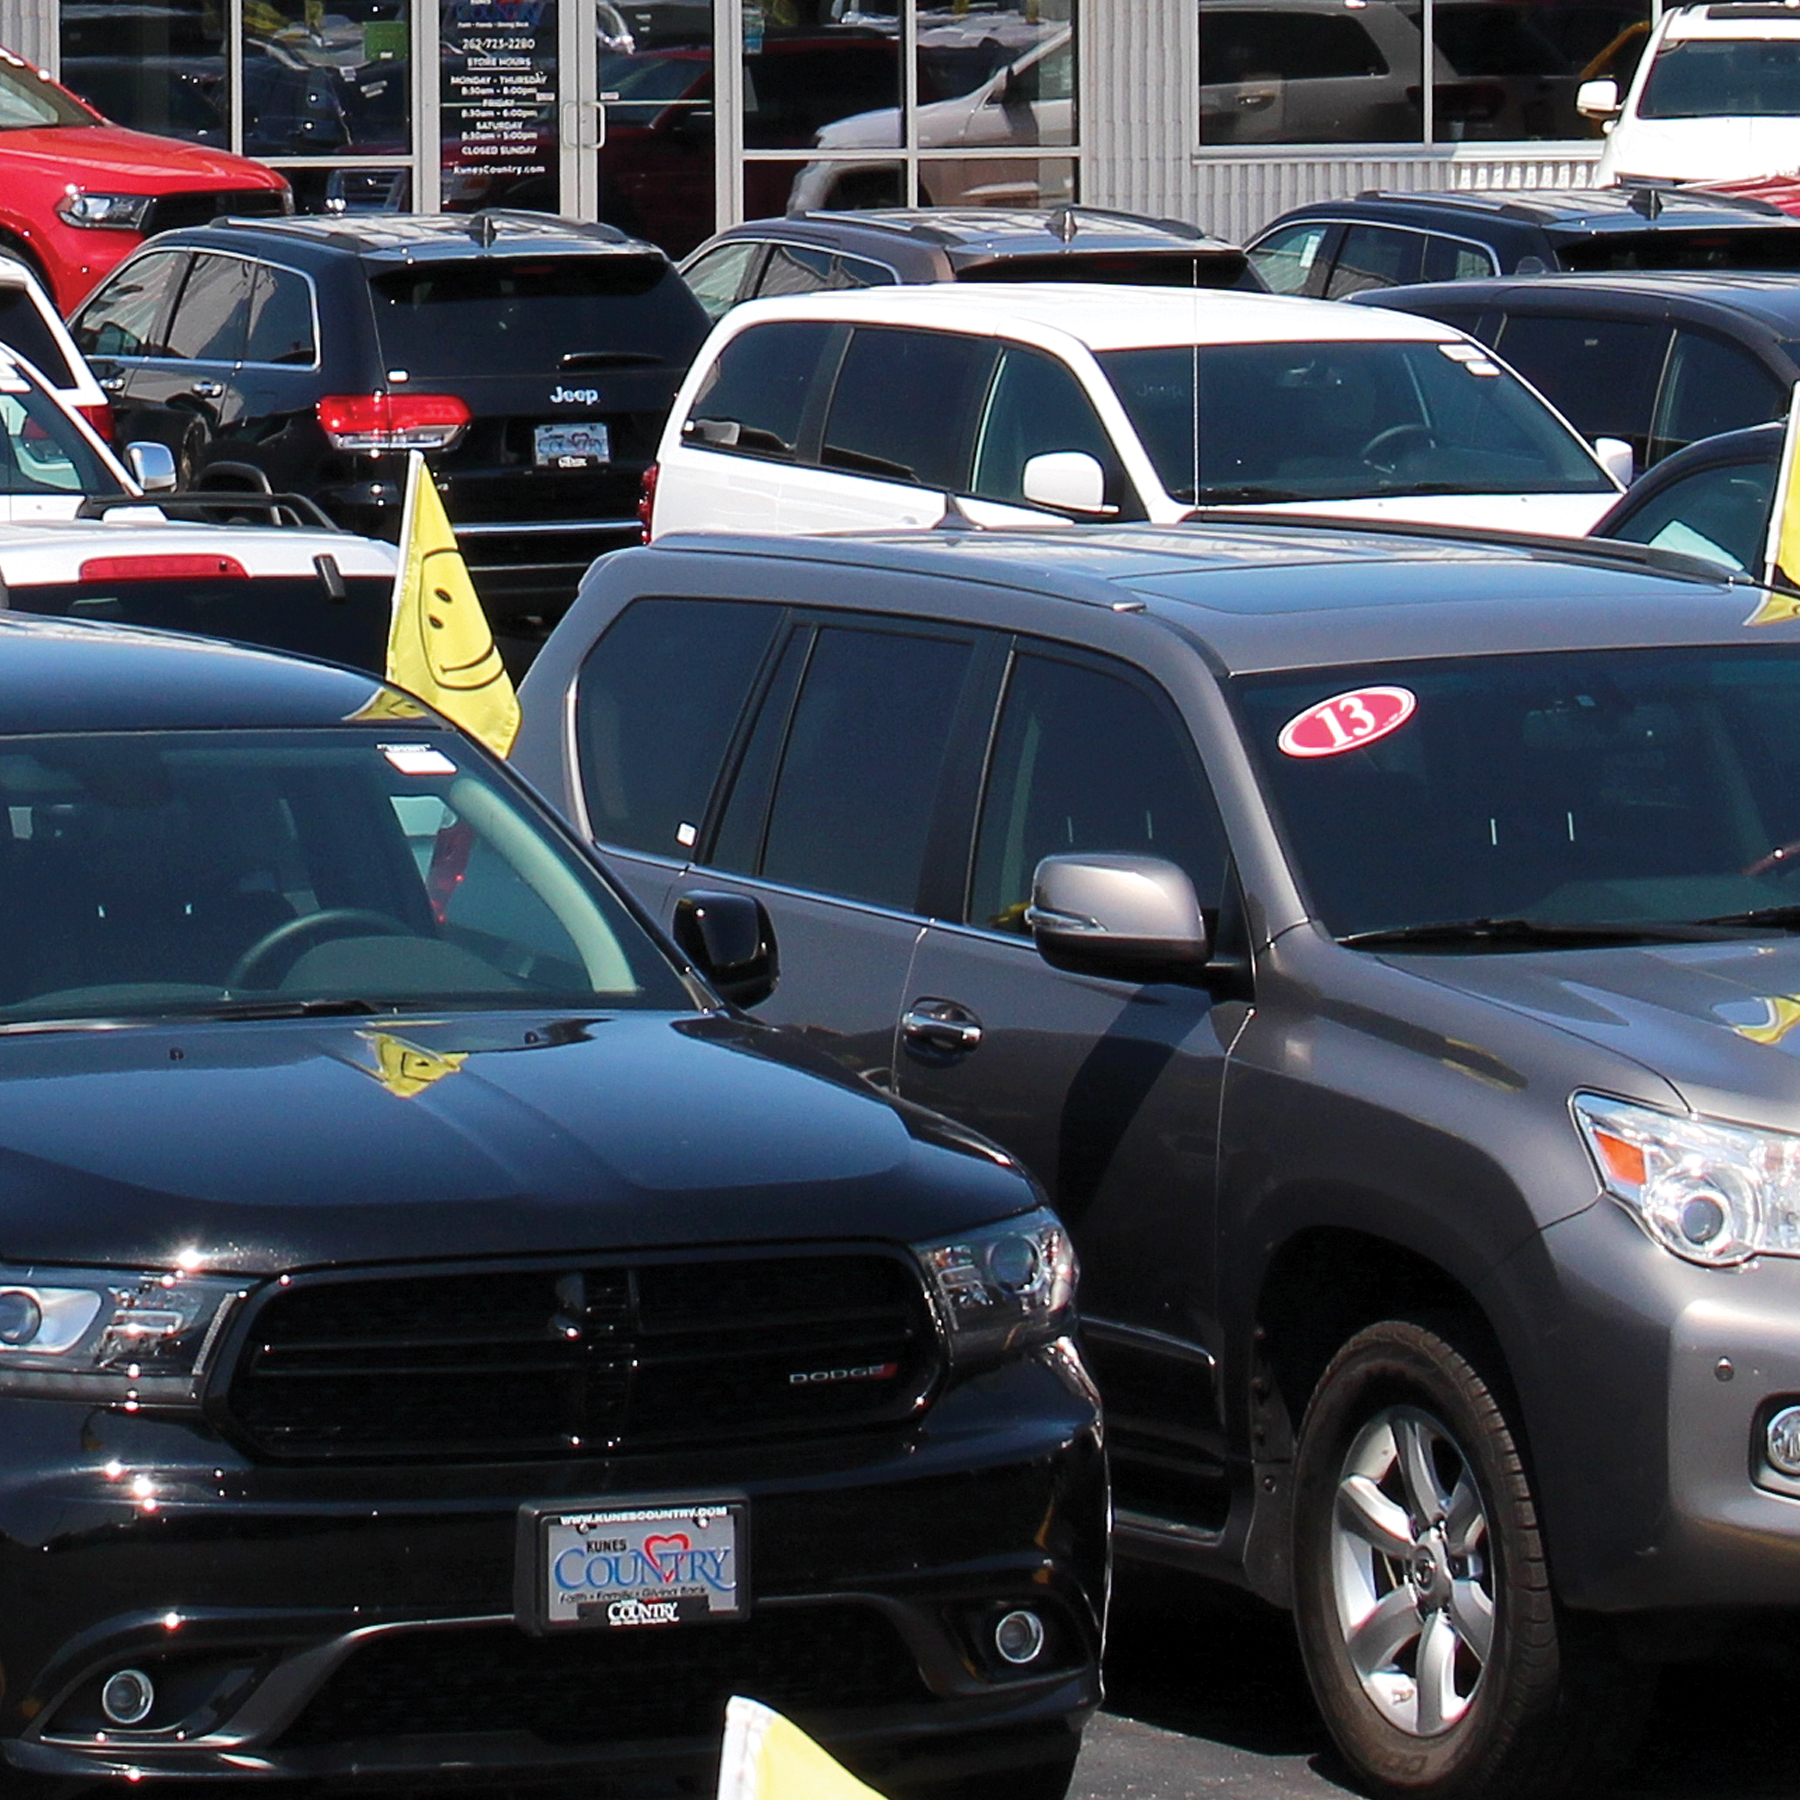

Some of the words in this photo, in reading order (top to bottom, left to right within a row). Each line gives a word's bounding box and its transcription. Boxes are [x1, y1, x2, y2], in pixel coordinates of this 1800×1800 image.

[451, 75, 491, 85] MONDAY
[499, 74, 548, 86] THURSDAY
[476, 121, 523, 130] SATURDAY
[461, 145, 498, 155] CLOSED
[500, 145, 537, 155] SUNDAY
[549, 386, 599, 406] Jeep
[1314, 696, 1376, 747] 13
[789, 1364, 885, 1384] DODGE
[560, 1505, 728, 1526] WWW.KUNESCOUNTRY.COM
[586, 1538, 628, 1552] KUNES
[553, 1547, 737, 1593] COUNTRY
[607, 1601, 681, 1622] COUNTRY
